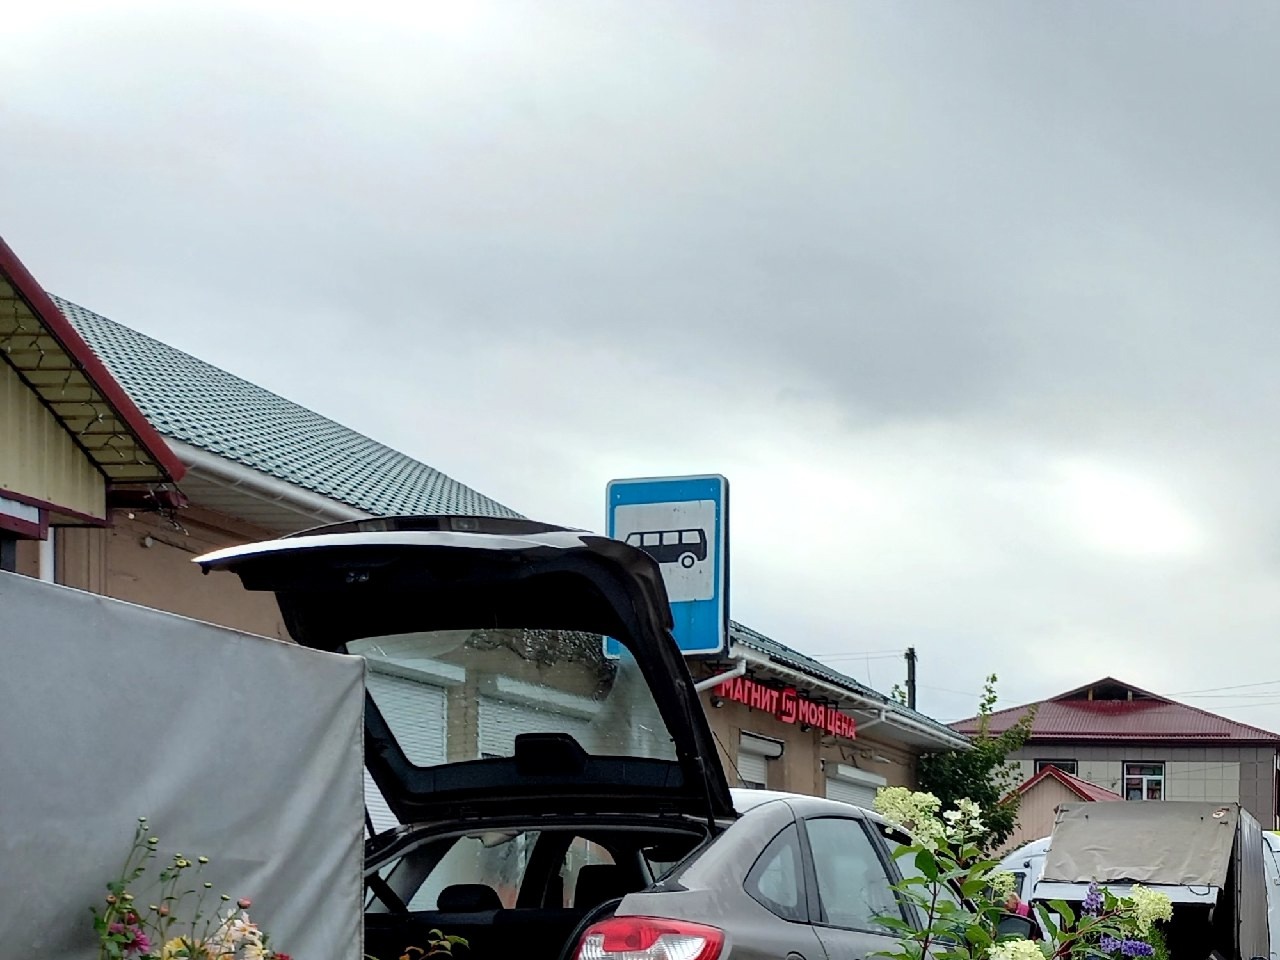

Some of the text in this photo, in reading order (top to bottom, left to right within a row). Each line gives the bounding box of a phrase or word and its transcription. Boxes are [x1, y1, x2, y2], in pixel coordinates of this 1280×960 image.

[722, 677, 779, 714] МАГНИТ
[799, 699, 825, 729] МОЯ
[827, 708, 856, 740] ЦЕНА
